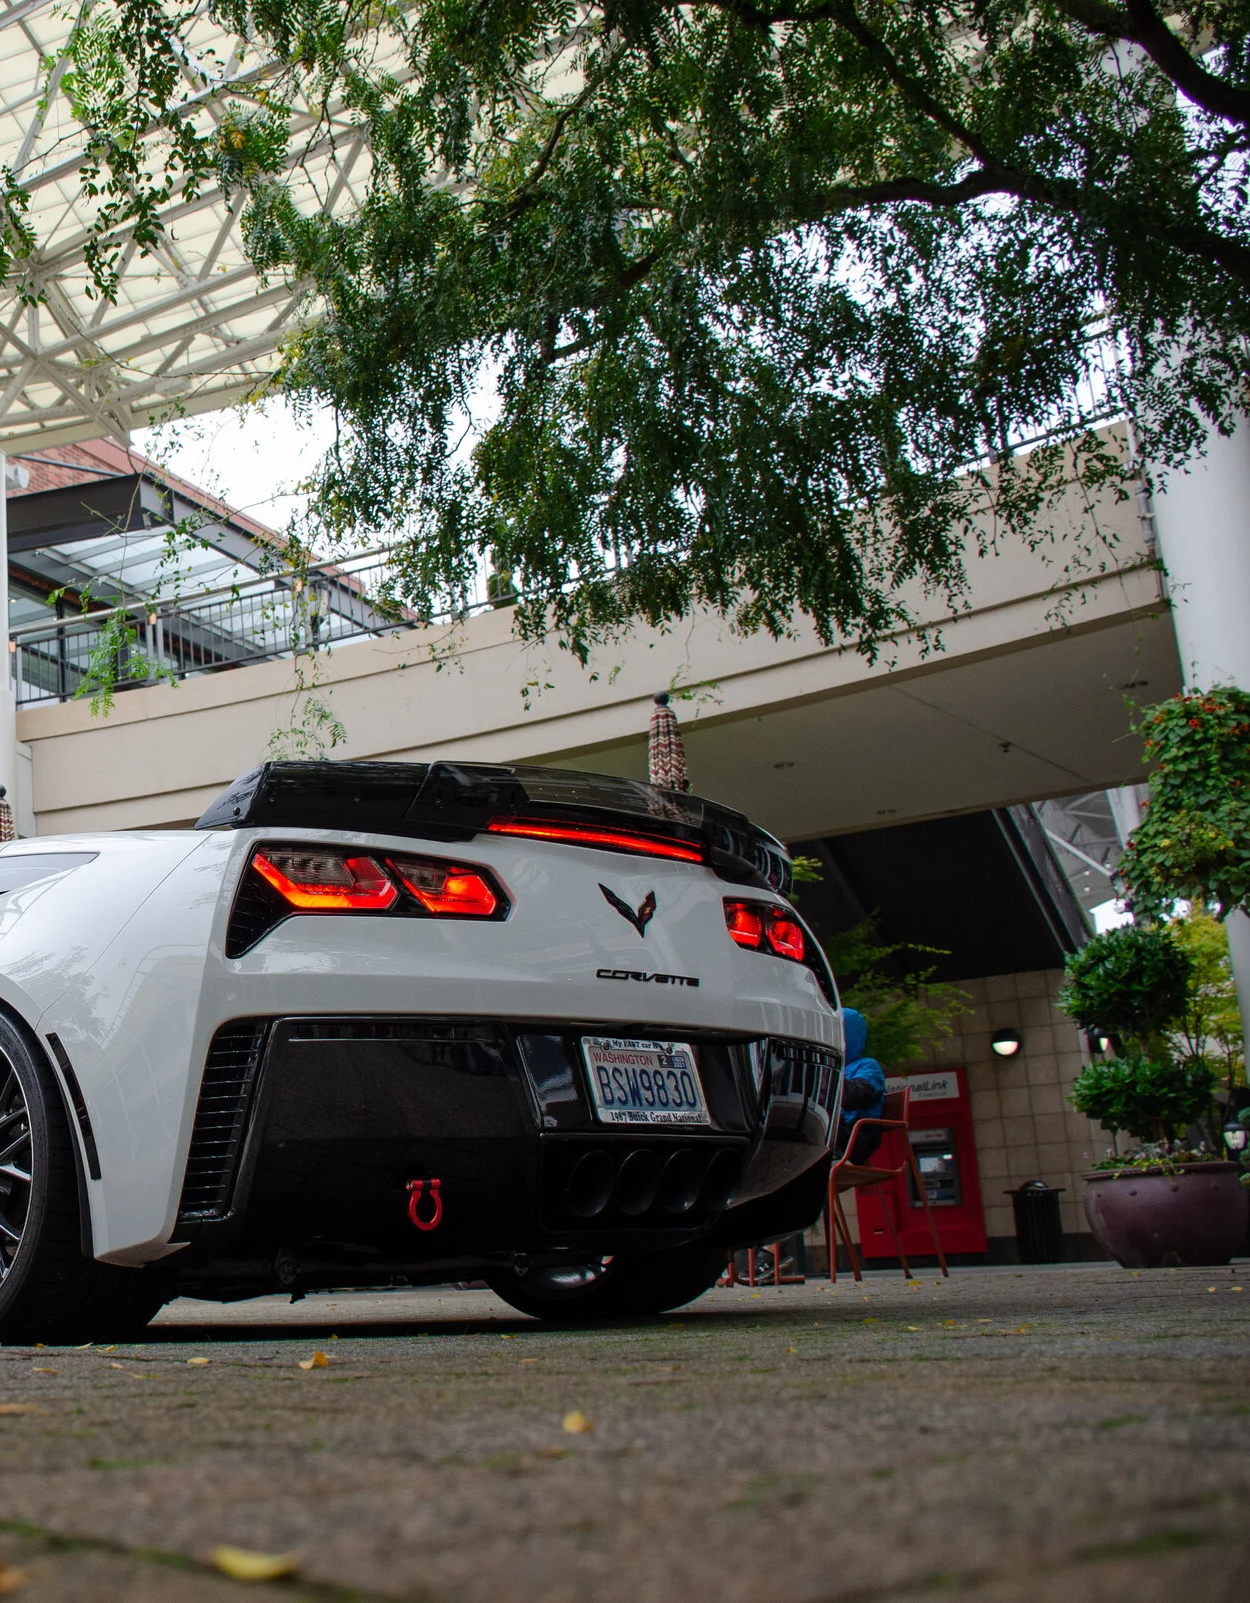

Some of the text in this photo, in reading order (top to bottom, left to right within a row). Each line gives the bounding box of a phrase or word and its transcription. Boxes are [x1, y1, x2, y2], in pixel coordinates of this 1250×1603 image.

[596, 968, 700, 987] CORVETTE
[612, 1040, 622, 1048] My
[623, 1040, 640, 1049] FAST
[593, 1052, 654, 1066] WASHINGTON
[596, 1066, 697, 1108] BSW9830
[885, 1080, 949, 1093] atinalLink
[610, 1111, 702, 1123] 1987 Buick Grand National
